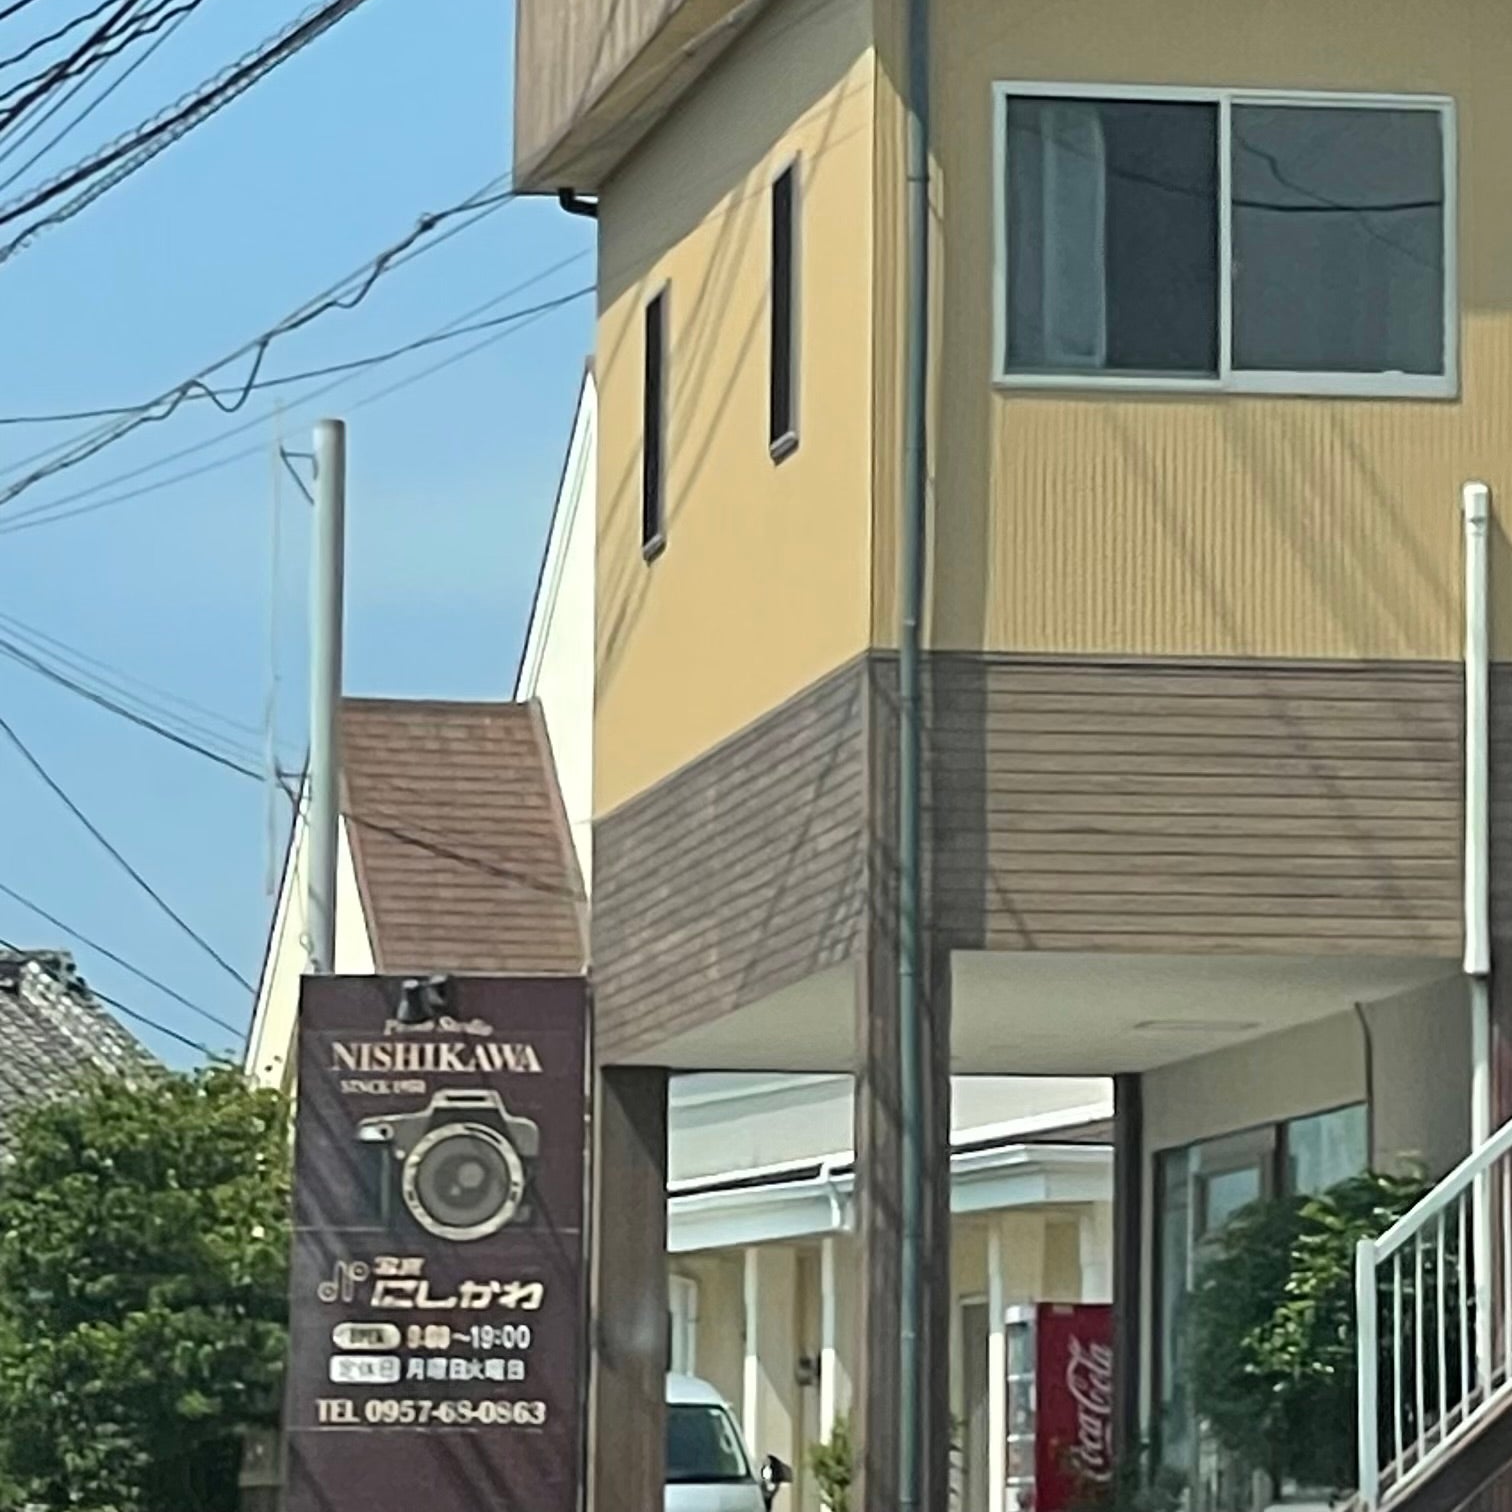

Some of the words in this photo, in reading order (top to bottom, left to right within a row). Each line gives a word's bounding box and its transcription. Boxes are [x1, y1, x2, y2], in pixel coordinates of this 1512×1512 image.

[330, 1041, 543, 1073] NISHIKAWA
[370, 1279, 544, 1310] にしかわ
[316, 1399, 361, 1423] TEL
